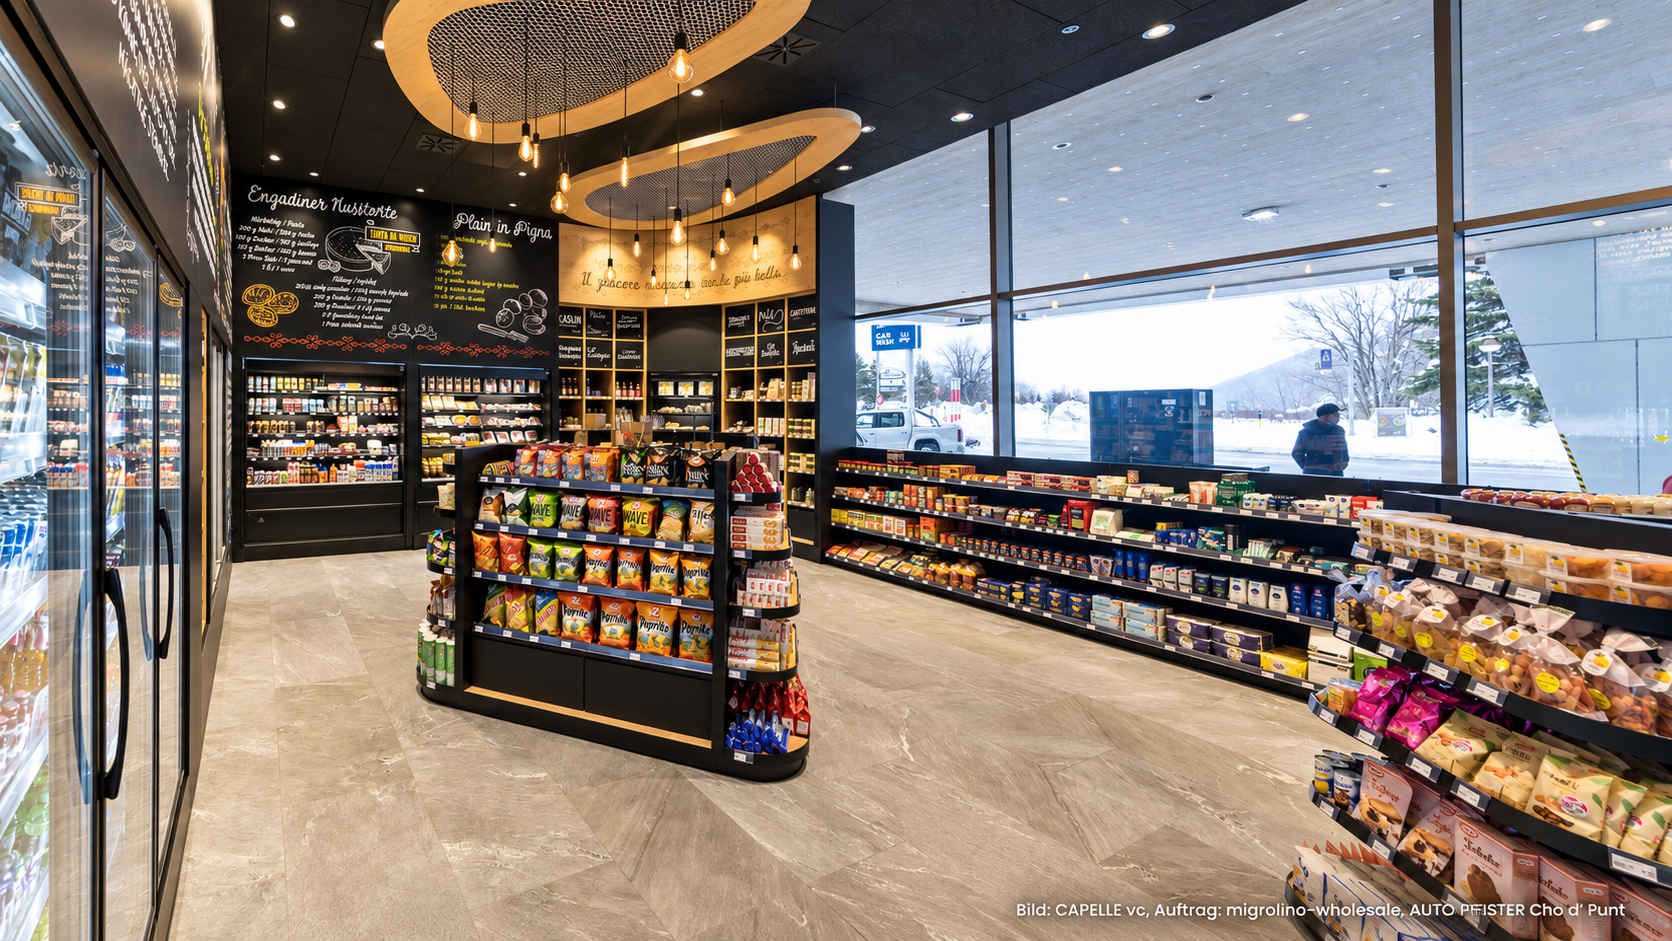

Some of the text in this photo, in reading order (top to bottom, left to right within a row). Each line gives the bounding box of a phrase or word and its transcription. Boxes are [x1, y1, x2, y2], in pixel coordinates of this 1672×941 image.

[248, 184, 328, 210] Engadiner
[452, 212, 492, 232] Plain
[497, 220, 511, 234] in
[513, 221, 553, 243] Pigna
[624, 510, 648, 525] WAVE
